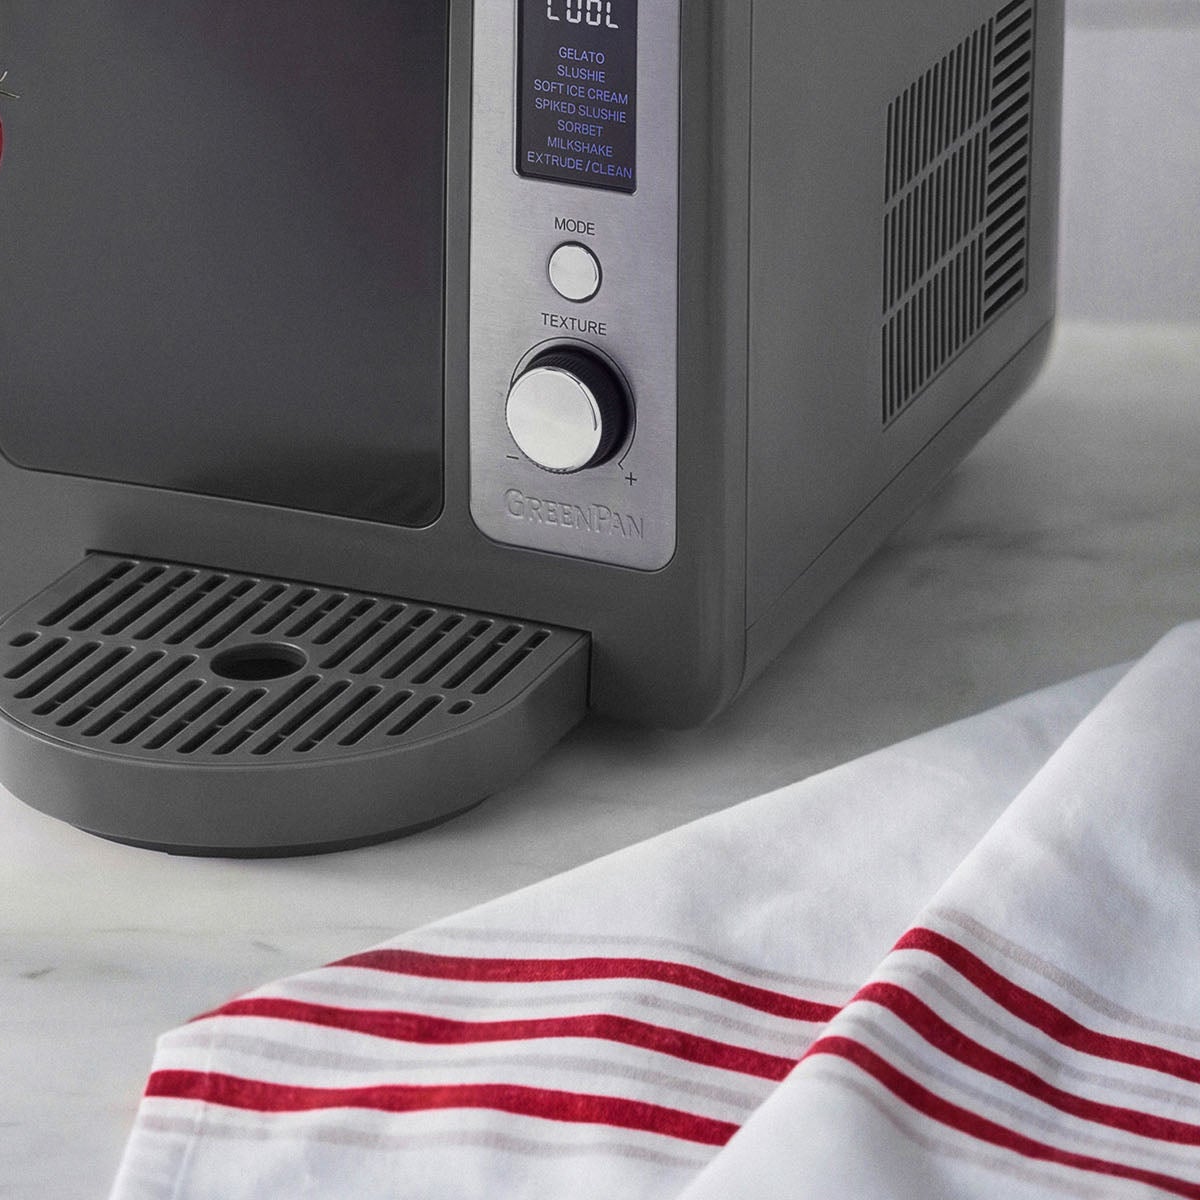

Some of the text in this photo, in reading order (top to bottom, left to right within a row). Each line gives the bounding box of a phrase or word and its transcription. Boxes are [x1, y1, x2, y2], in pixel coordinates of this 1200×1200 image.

[558, 46, 605, 64] GELATO
[557, 64, 605, 83] SLUSHIE
[534, 79, 628, 105] SOFT ICE CREAM
[535, 97, 626, 123] SPIKED SLUSHIE
[557, 119, 604, 137] SORBET
[547, 136, 613, 157] MILKSHAKE
[554, 217, 595, 236] MODE
[541, 312, 607, 336] TEXTURE
